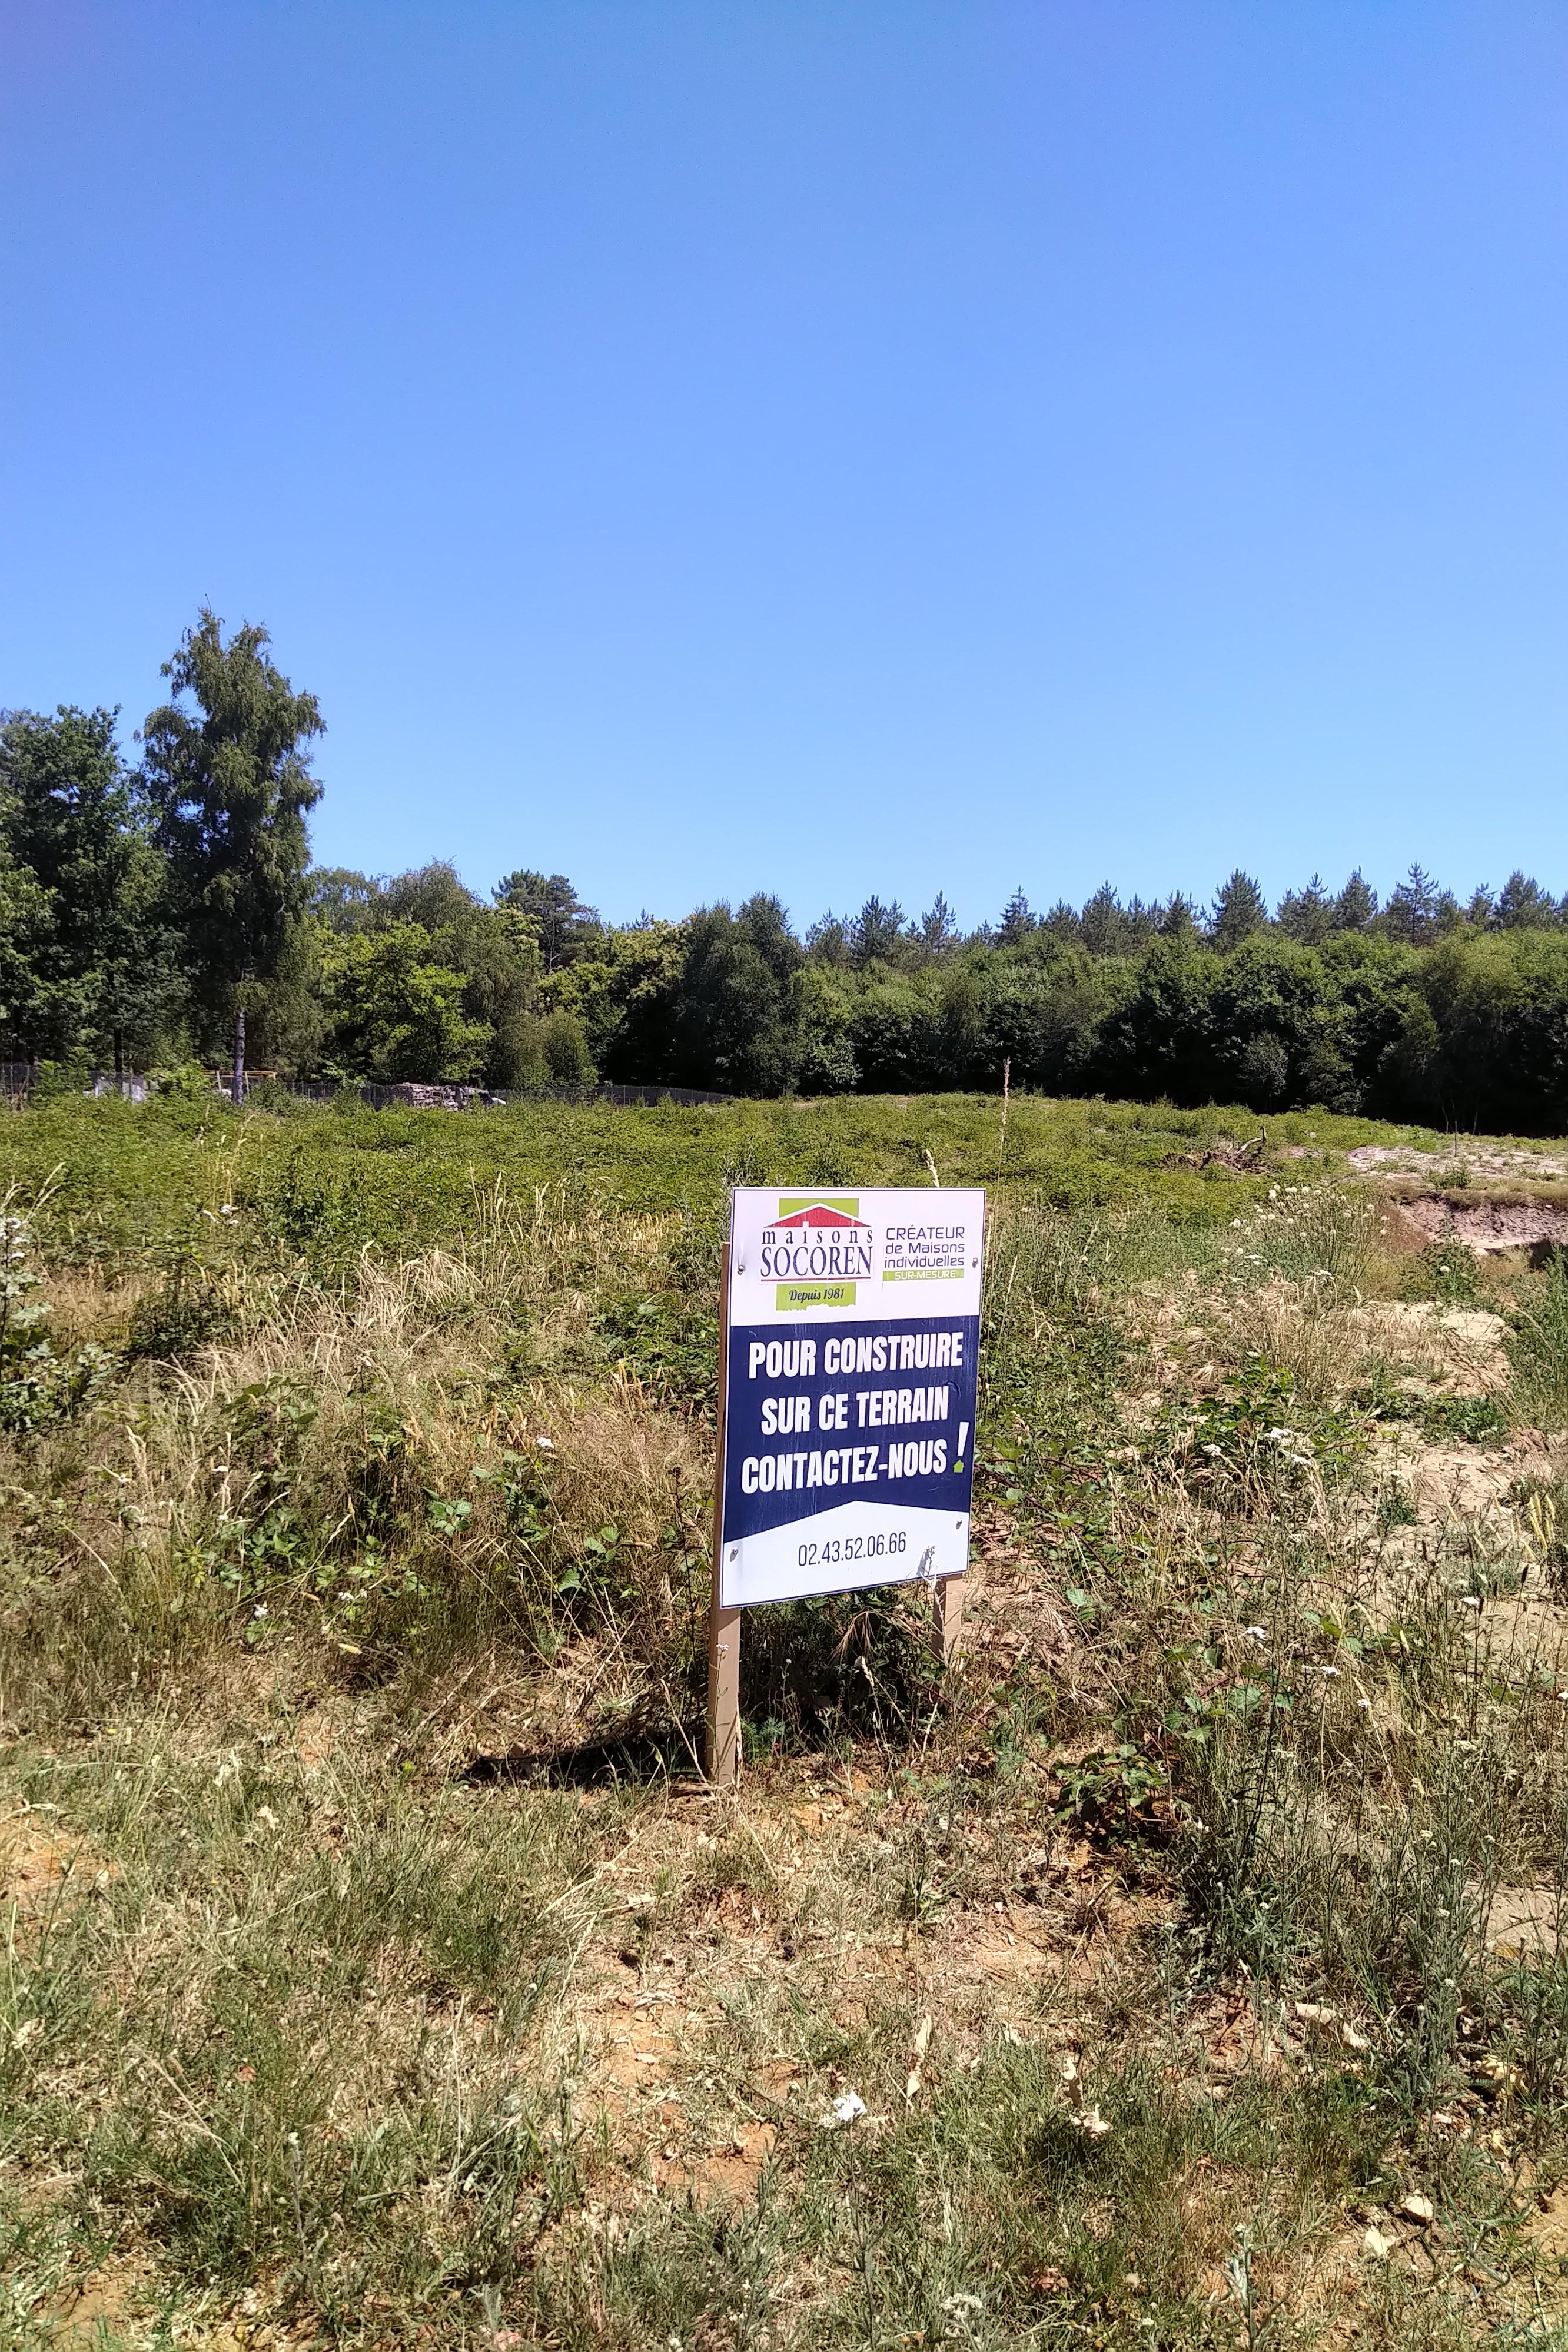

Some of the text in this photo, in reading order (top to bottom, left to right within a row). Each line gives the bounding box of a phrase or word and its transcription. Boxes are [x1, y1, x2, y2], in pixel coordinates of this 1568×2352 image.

[886, 1224, 965, 1240] CRÉATEUR
[886, 1242, 965, 1254] de Maisons
[760, 1245, 873, 1277] SOCOREN
[885, 1255, 965, 1268] individuelles
[895, 1270, 956, 1280] SUR-MESURE
[789, 1288, 845, 1303] Depuis 1981
[749, 1331, 964, 1379] POUR CONSTRUIRE
[761, 1386, 949, 1436] SUR CE TERRAIN
[742, 1439, 948, 1494] CONTACTEZ-NOUS
[798, 1531, 906, 1567] 02.43.52.06.66
